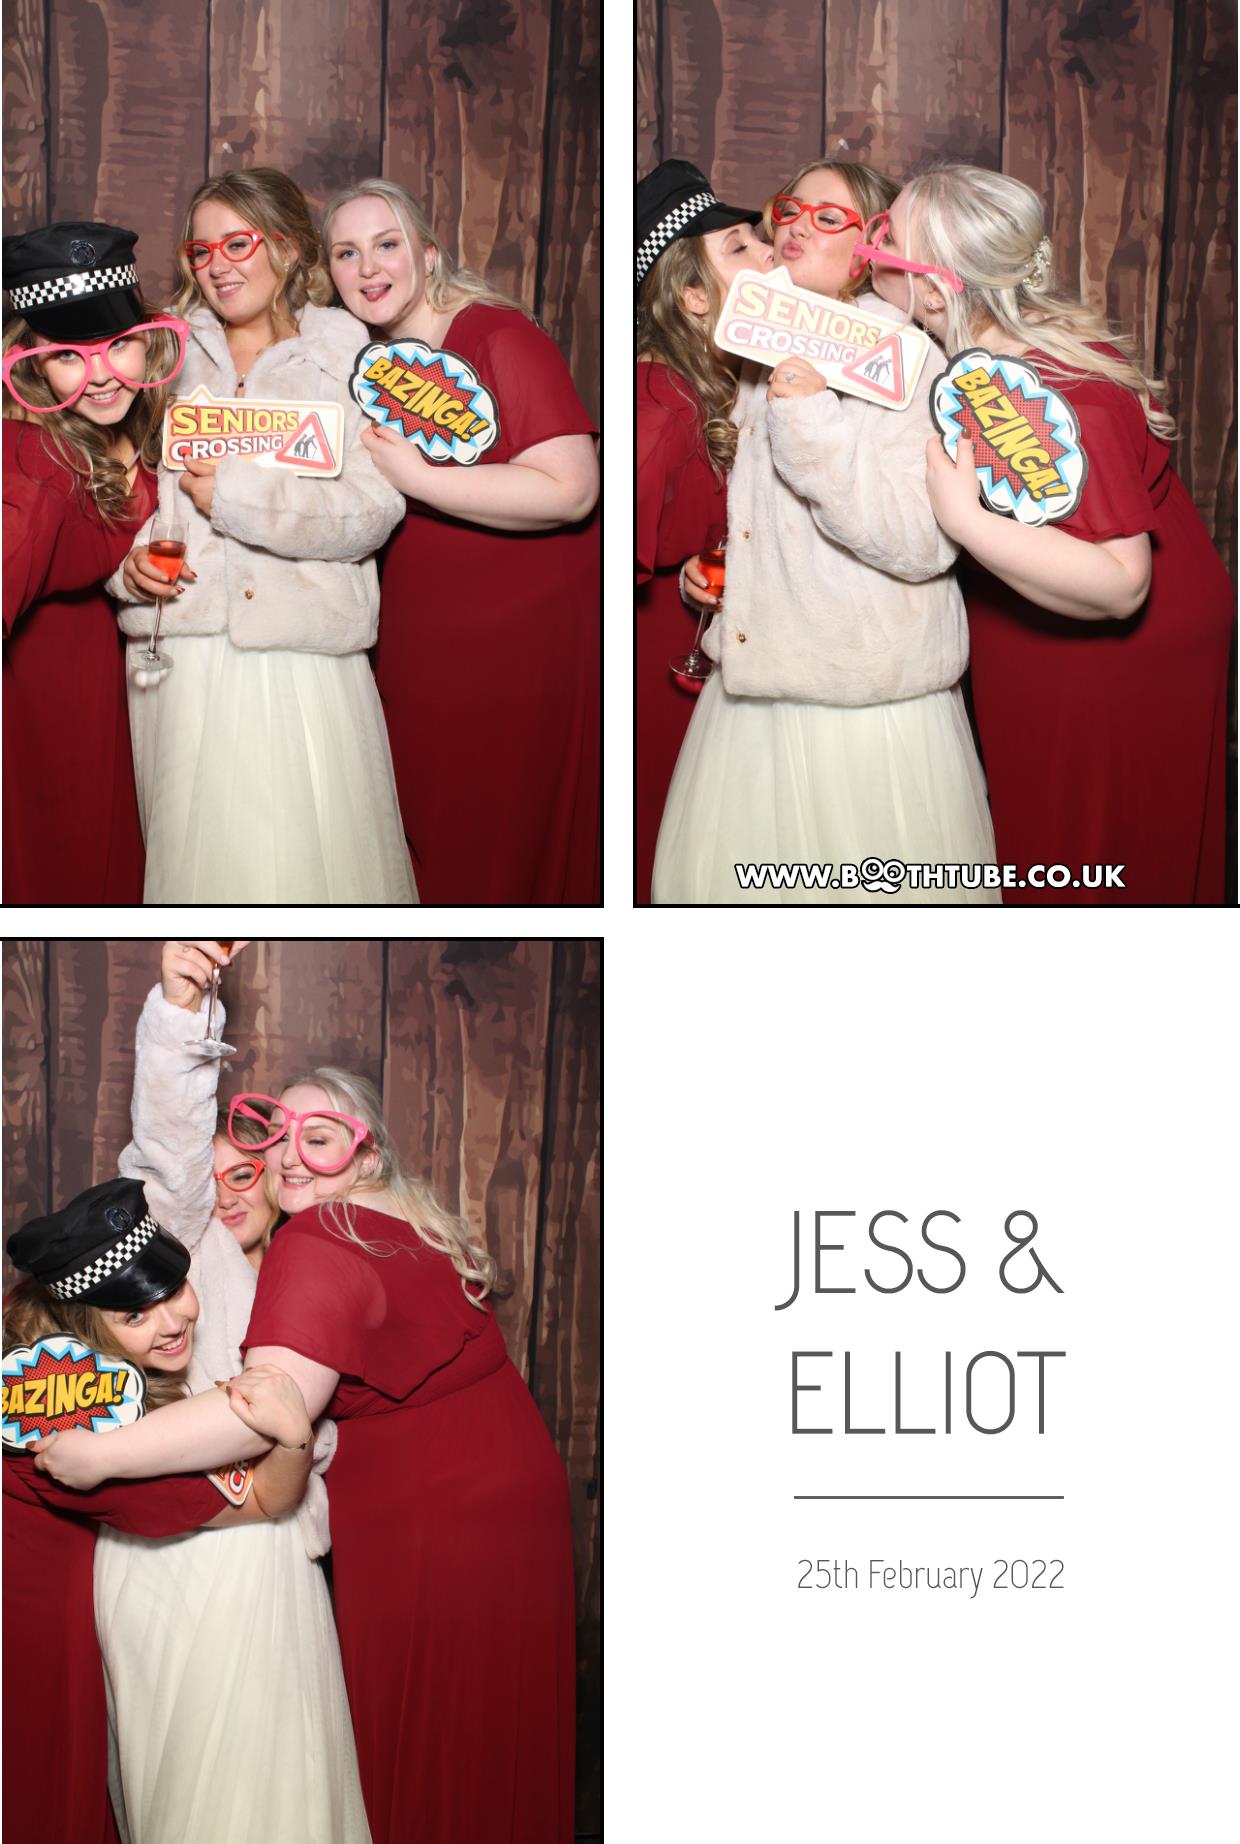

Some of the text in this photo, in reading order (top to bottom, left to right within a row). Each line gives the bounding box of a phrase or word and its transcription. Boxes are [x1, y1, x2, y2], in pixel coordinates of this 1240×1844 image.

[724, 320, 857, 364] CROSSING
[734, 282, 880, 348] SENIORS
[170, 404, 300, 437] SENIORS
[362, 355, 490, 442] BAZINGA!
[170, 433, 284, 463] CROSSING
[952, 366, 1070, 501] BAZINGA!
